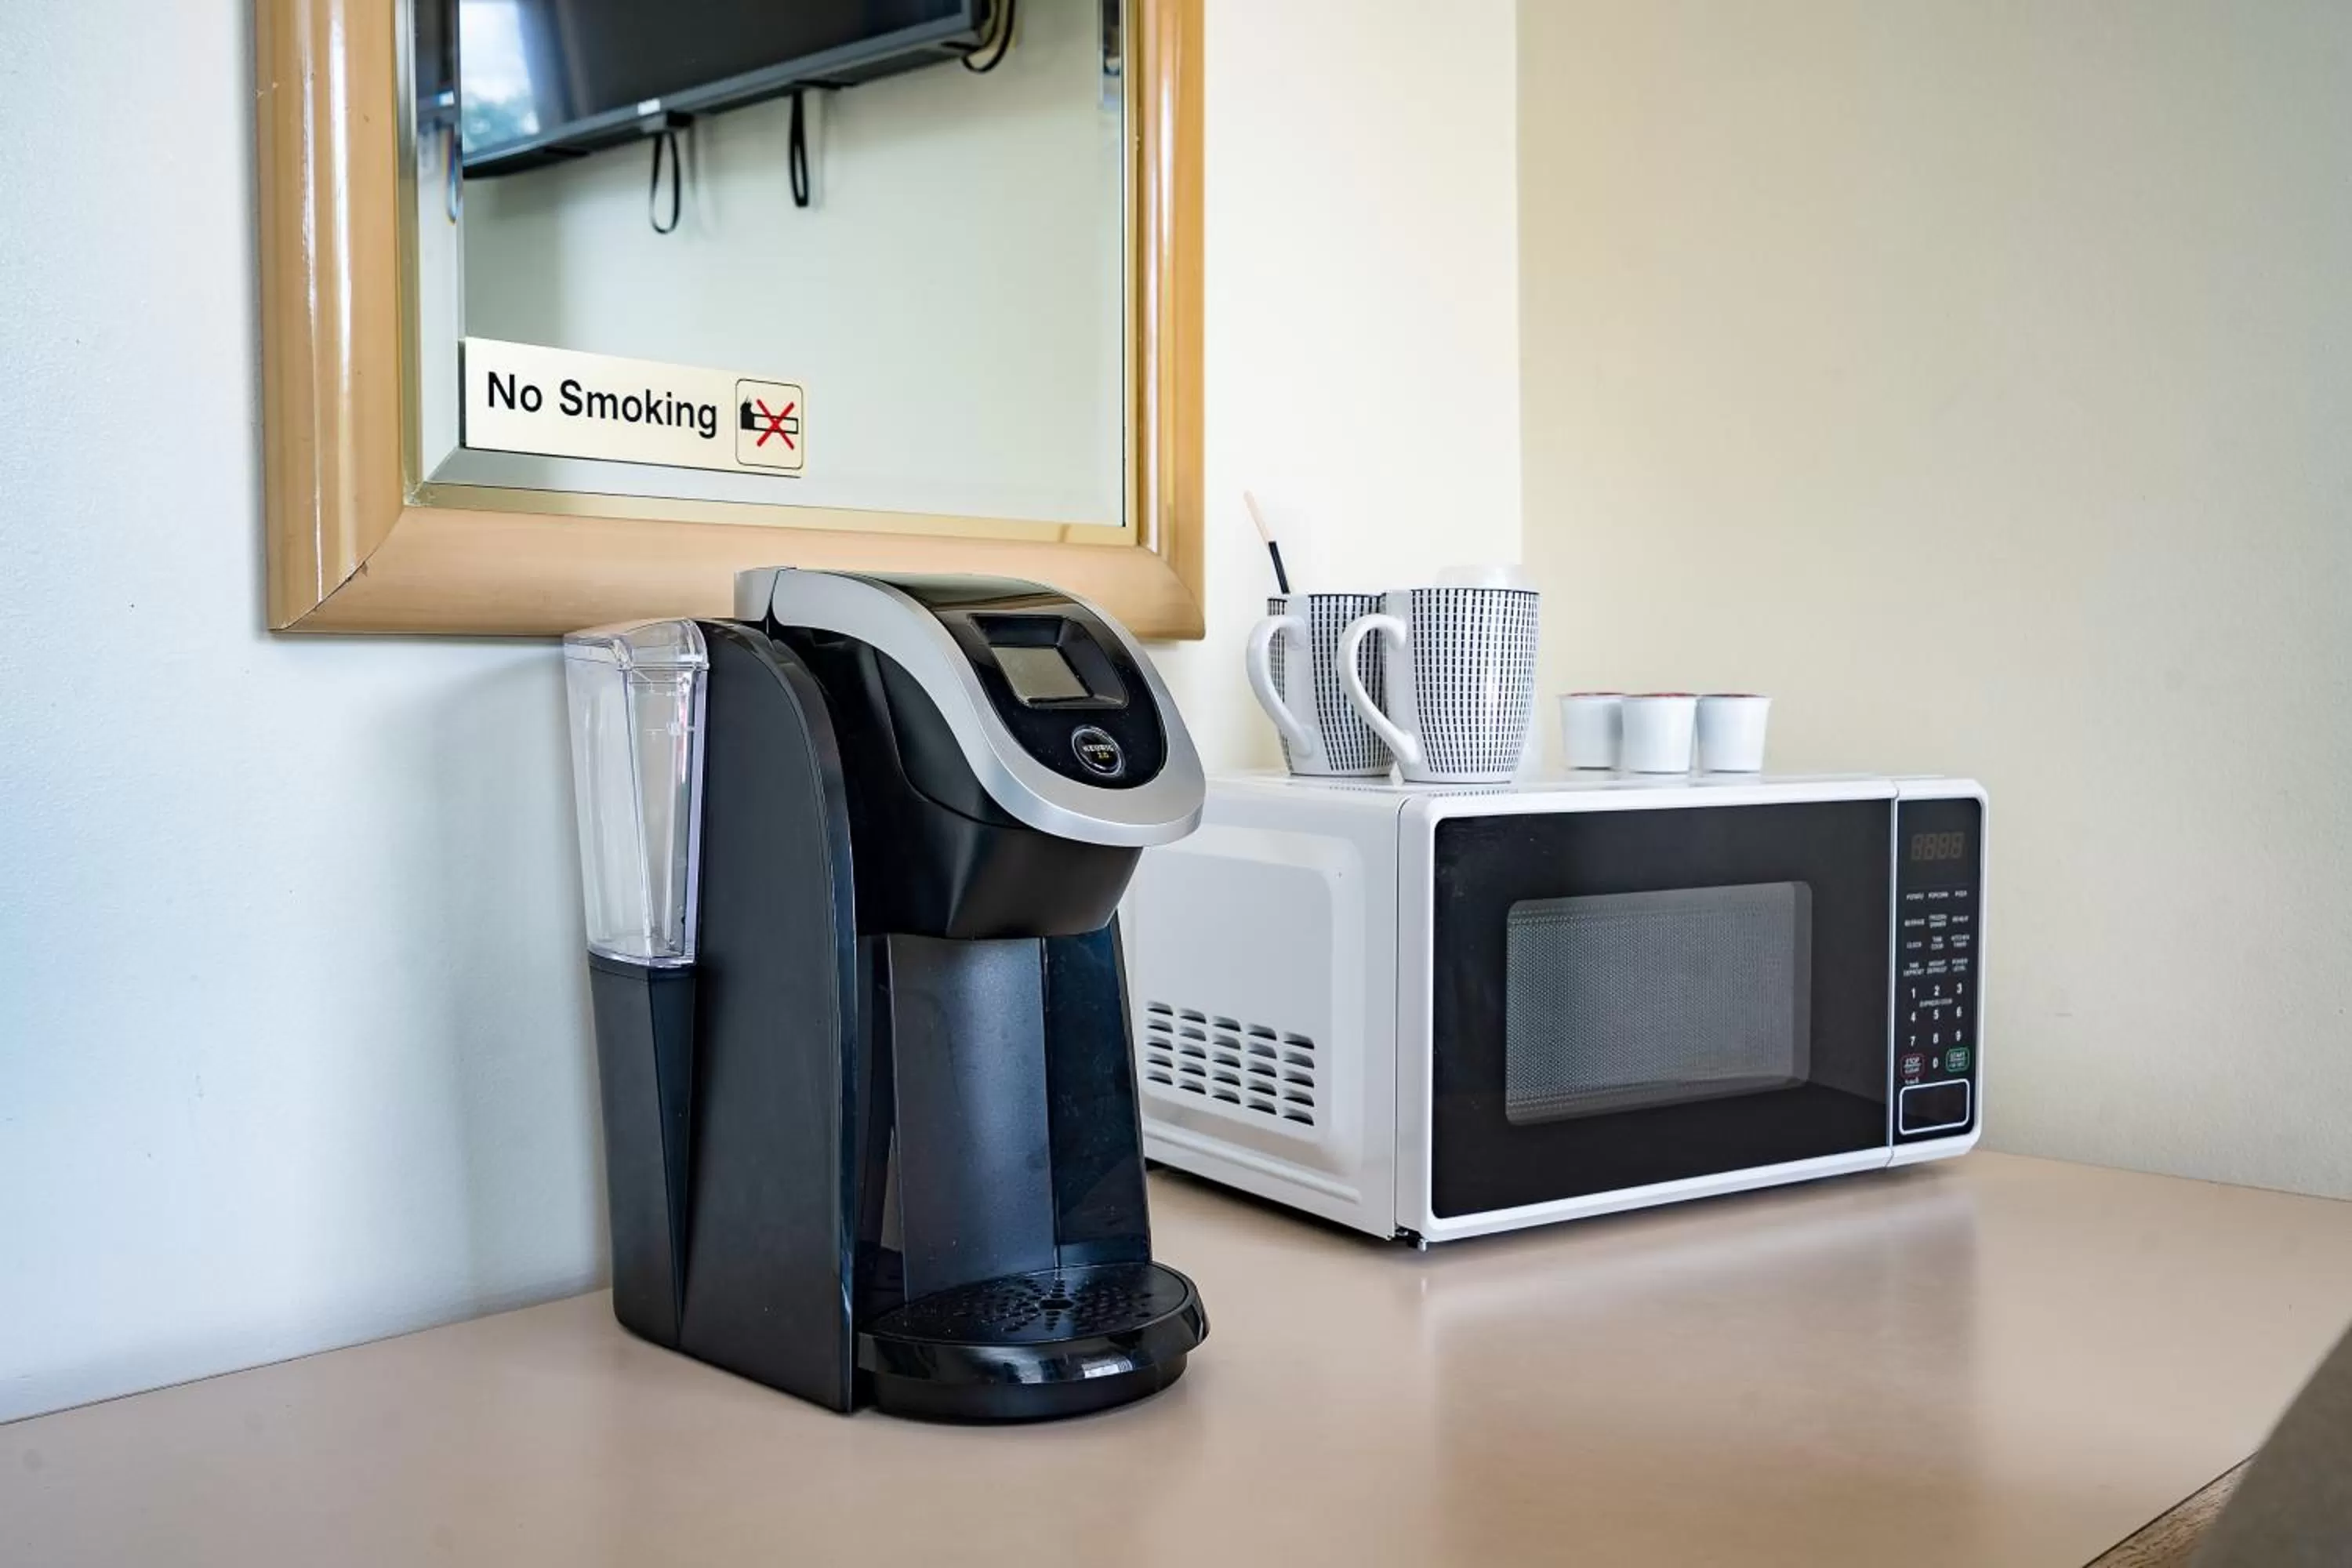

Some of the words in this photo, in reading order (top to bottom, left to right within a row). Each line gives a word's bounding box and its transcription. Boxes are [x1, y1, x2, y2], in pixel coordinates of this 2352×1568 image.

[488, 372, 542, 413] No
[559, 379, 717, 439] Smoking
[1911, 987, 1916, 999] 1
[1934, 984, 1940, 996] 2
[1956, 982, 1962, 994] 3
[1911, 1011, 1916, 1022] 4
[1933, 1009, 1939, 1020] 5
[1956, 1006, 1962, 1018] 6
[1910, 1036, 1916, 1047] 7
[1933, 1032, 1939, 1044] 8
[1955, 1029, 1962, 1041] 9
[1933, 1057, 1939, 1069] 0
